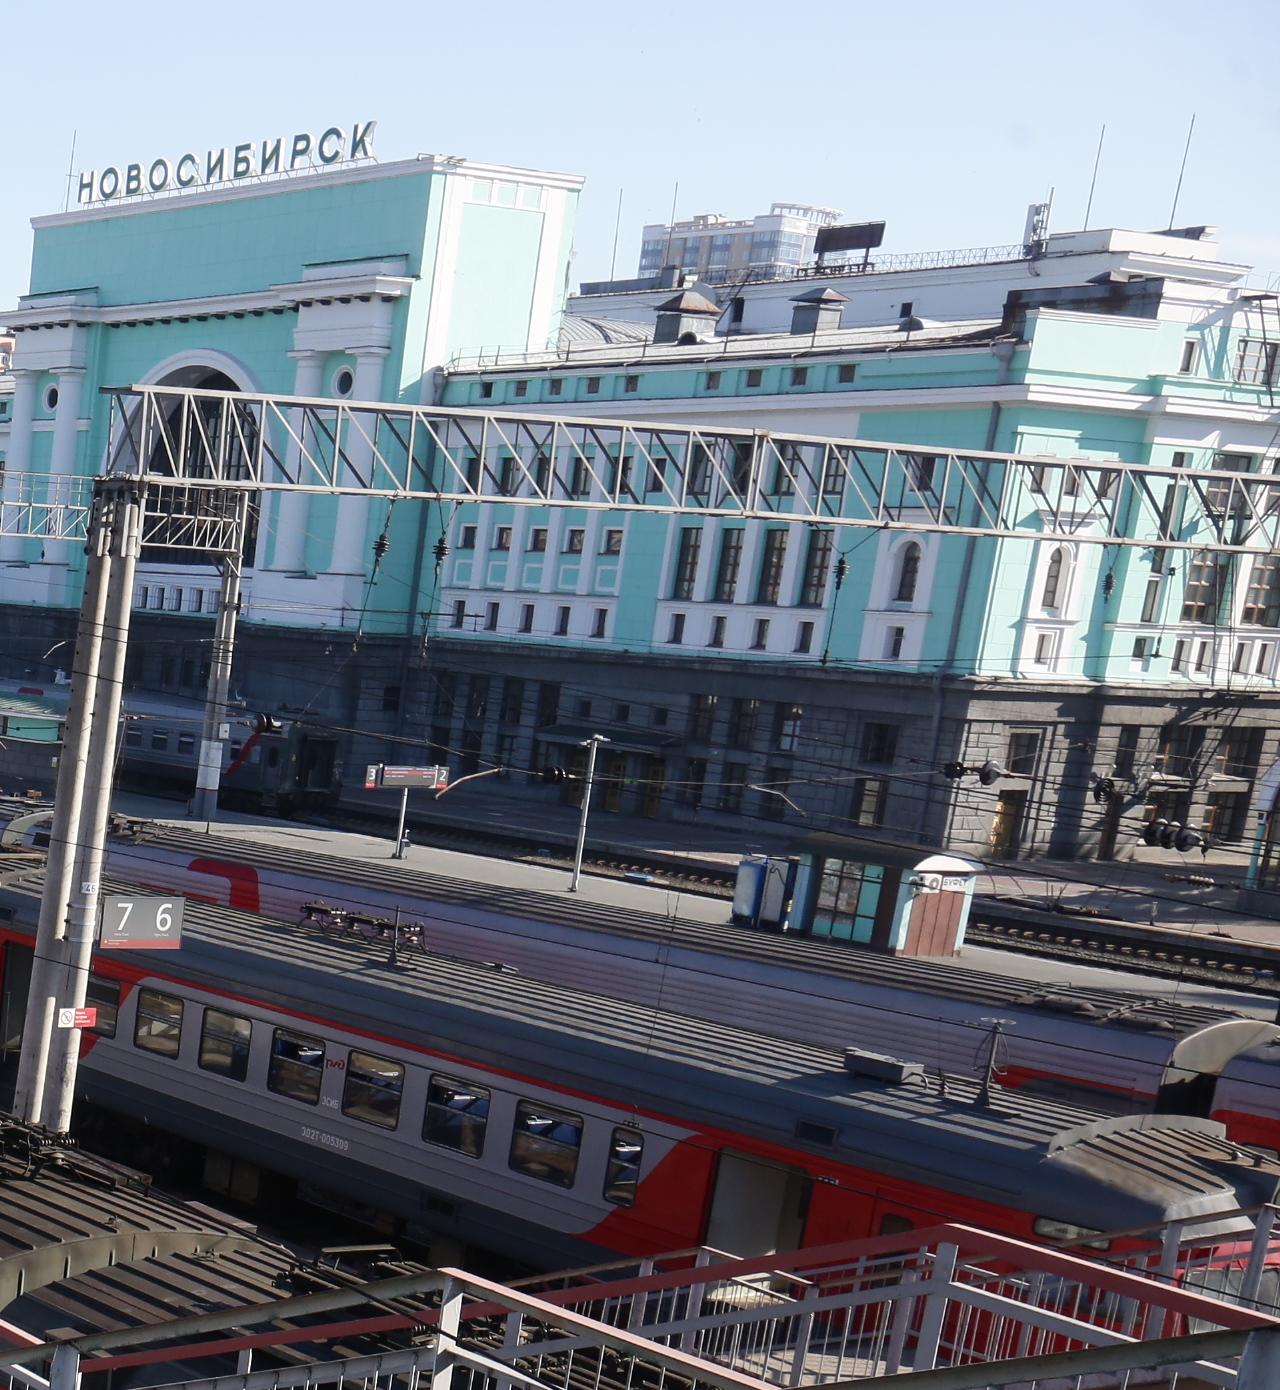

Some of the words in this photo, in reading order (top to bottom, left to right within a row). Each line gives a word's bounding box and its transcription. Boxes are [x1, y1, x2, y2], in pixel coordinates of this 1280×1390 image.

[77, 119, 378, 203] НОВОСИБИРСК
[368, 768, 377, 780] 3
[439, 769, 447, 781] 2
[117, 902, 134, 931] 7
[155, 902, 173, 932] 6
